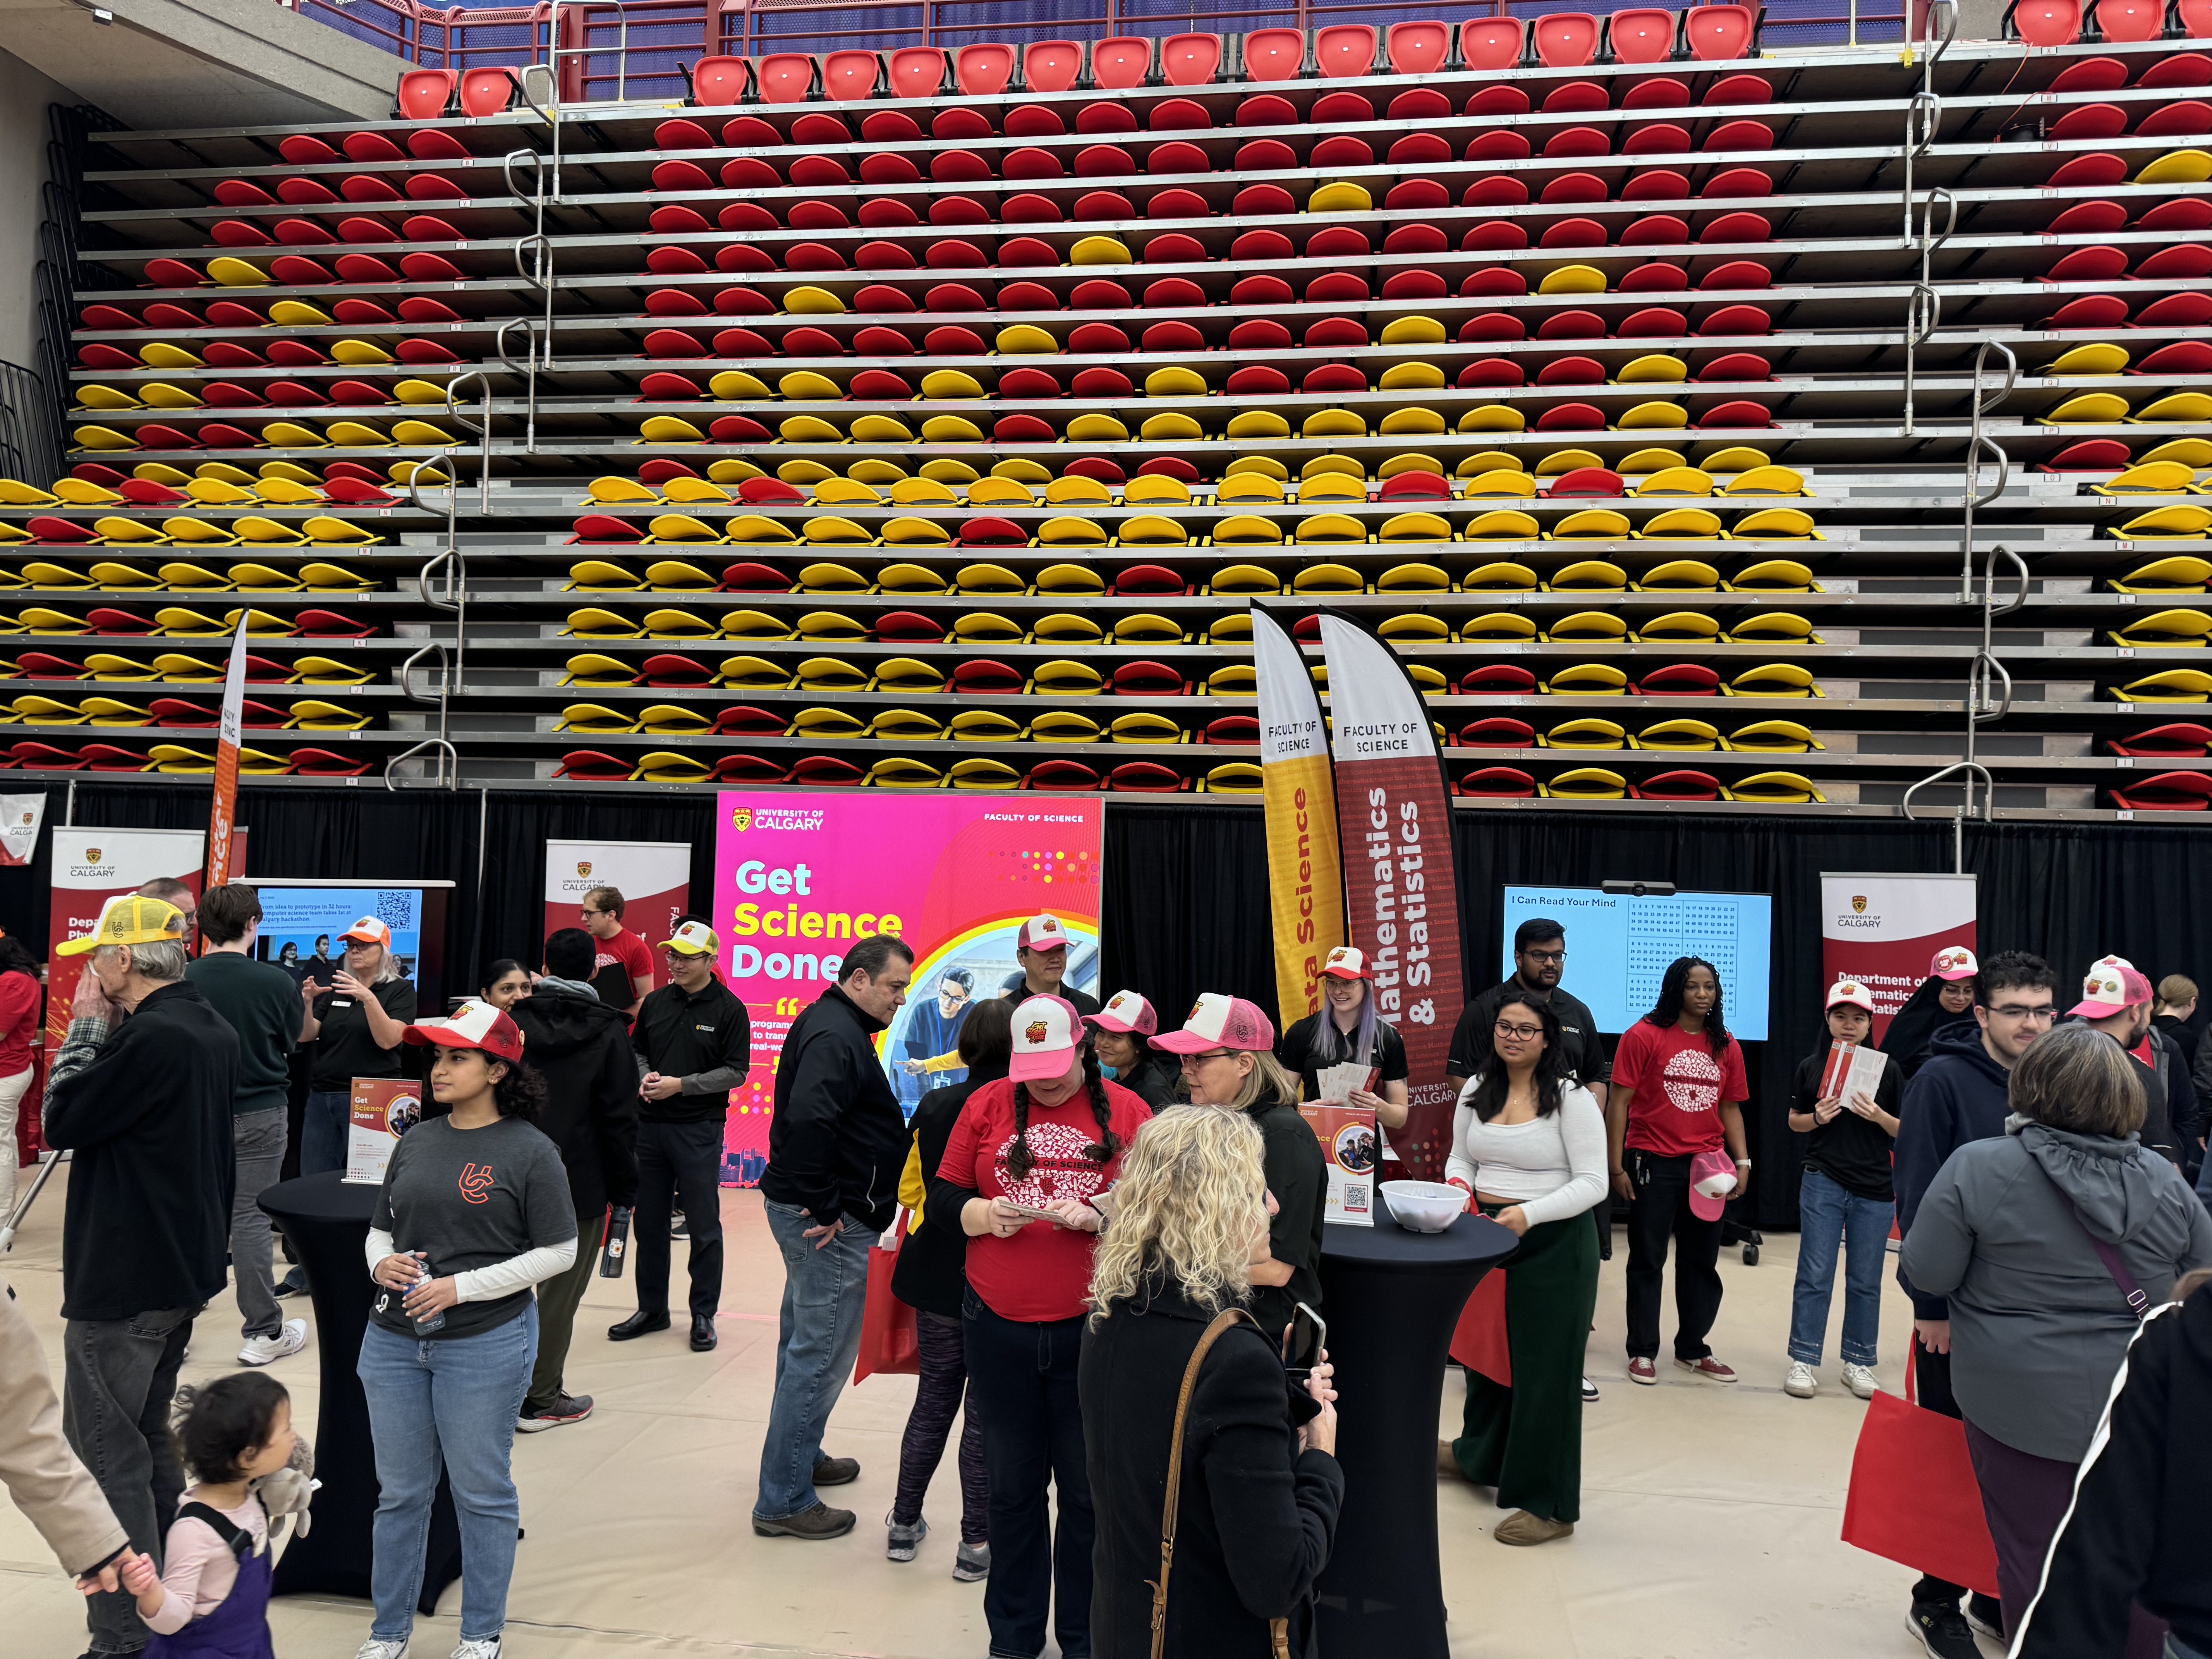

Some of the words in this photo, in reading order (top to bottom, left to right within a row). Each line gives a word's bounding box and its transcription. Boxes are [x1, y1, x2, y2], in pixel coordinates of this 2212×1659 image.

[1269, 722, 1302, 737] FACULTY
[1305, 721, 1316, 732] OF
[1343, 724, 1396, 737] FACULTY
[1402, 723, 1417, 733] OF
[1278, 738, 1310, 753] SCIENCE
[1357, 740, 1408, 752] SCIENCE
[756, 808, 809, 817] UNIVERSITY
[755, 816, 824, 830] CALGARY
[1294, 787, 1314, 944] Science
[736, 860, 811, 895] Get
[1397, 801, 1431, 987] Statistics
[1517, 896, 1537, 904] Can
[1540, 897, 1564, 905] Read
[1567, 898, 1589, 906] Your
[1592, 899, 1616, 907] Mind
[733, 903, 903, 939] Science
[732, 945, 843, 981] Done
[1839, 972, 1911, 987] Department
[1409, 998, 1435, 1025] &
[1060, 1161, 1104, 1171] SCIENCE
